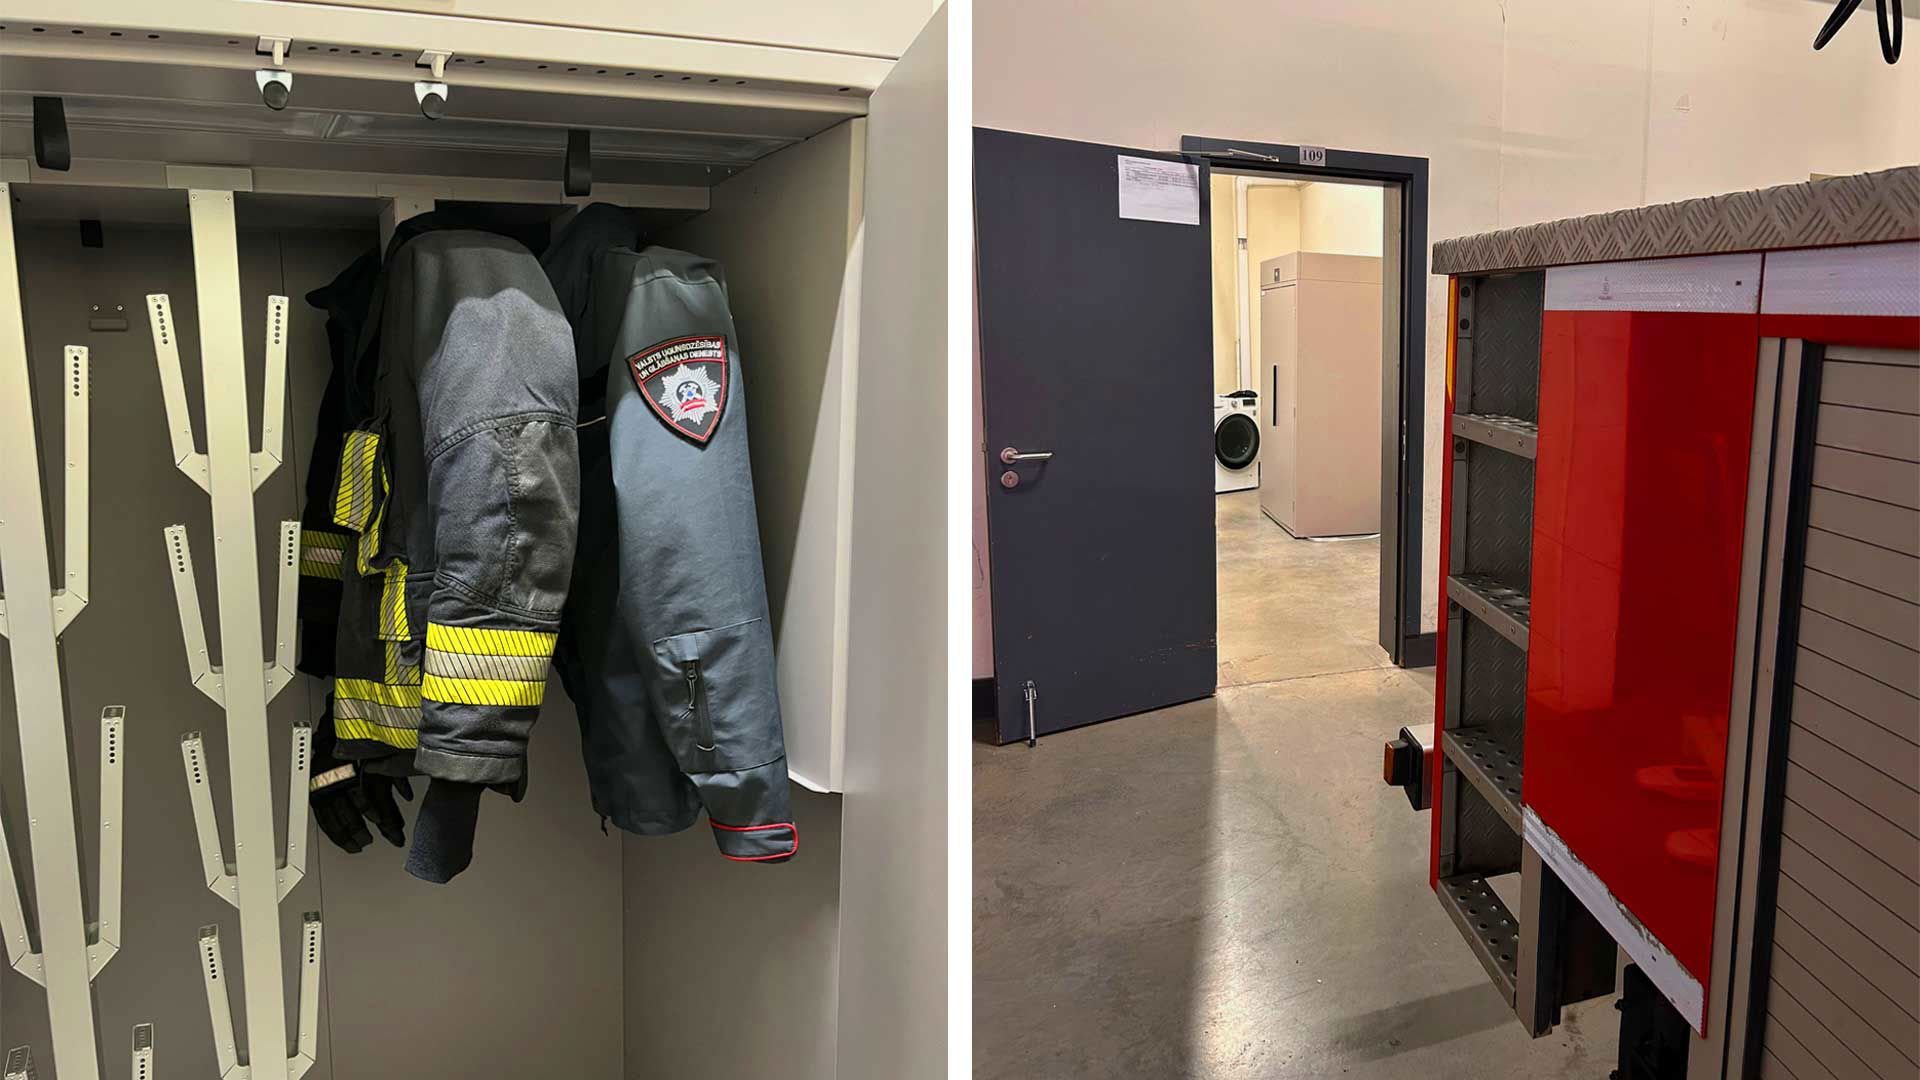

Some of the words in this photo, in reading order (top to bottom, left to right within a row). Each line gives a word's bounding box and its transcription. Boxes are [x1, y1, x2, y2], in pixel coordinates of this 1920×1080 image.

[1303, 150, 1323, 161] 109
[635, 352, 661, 369] VALSTS
[639, 370, 650, 379] UN
